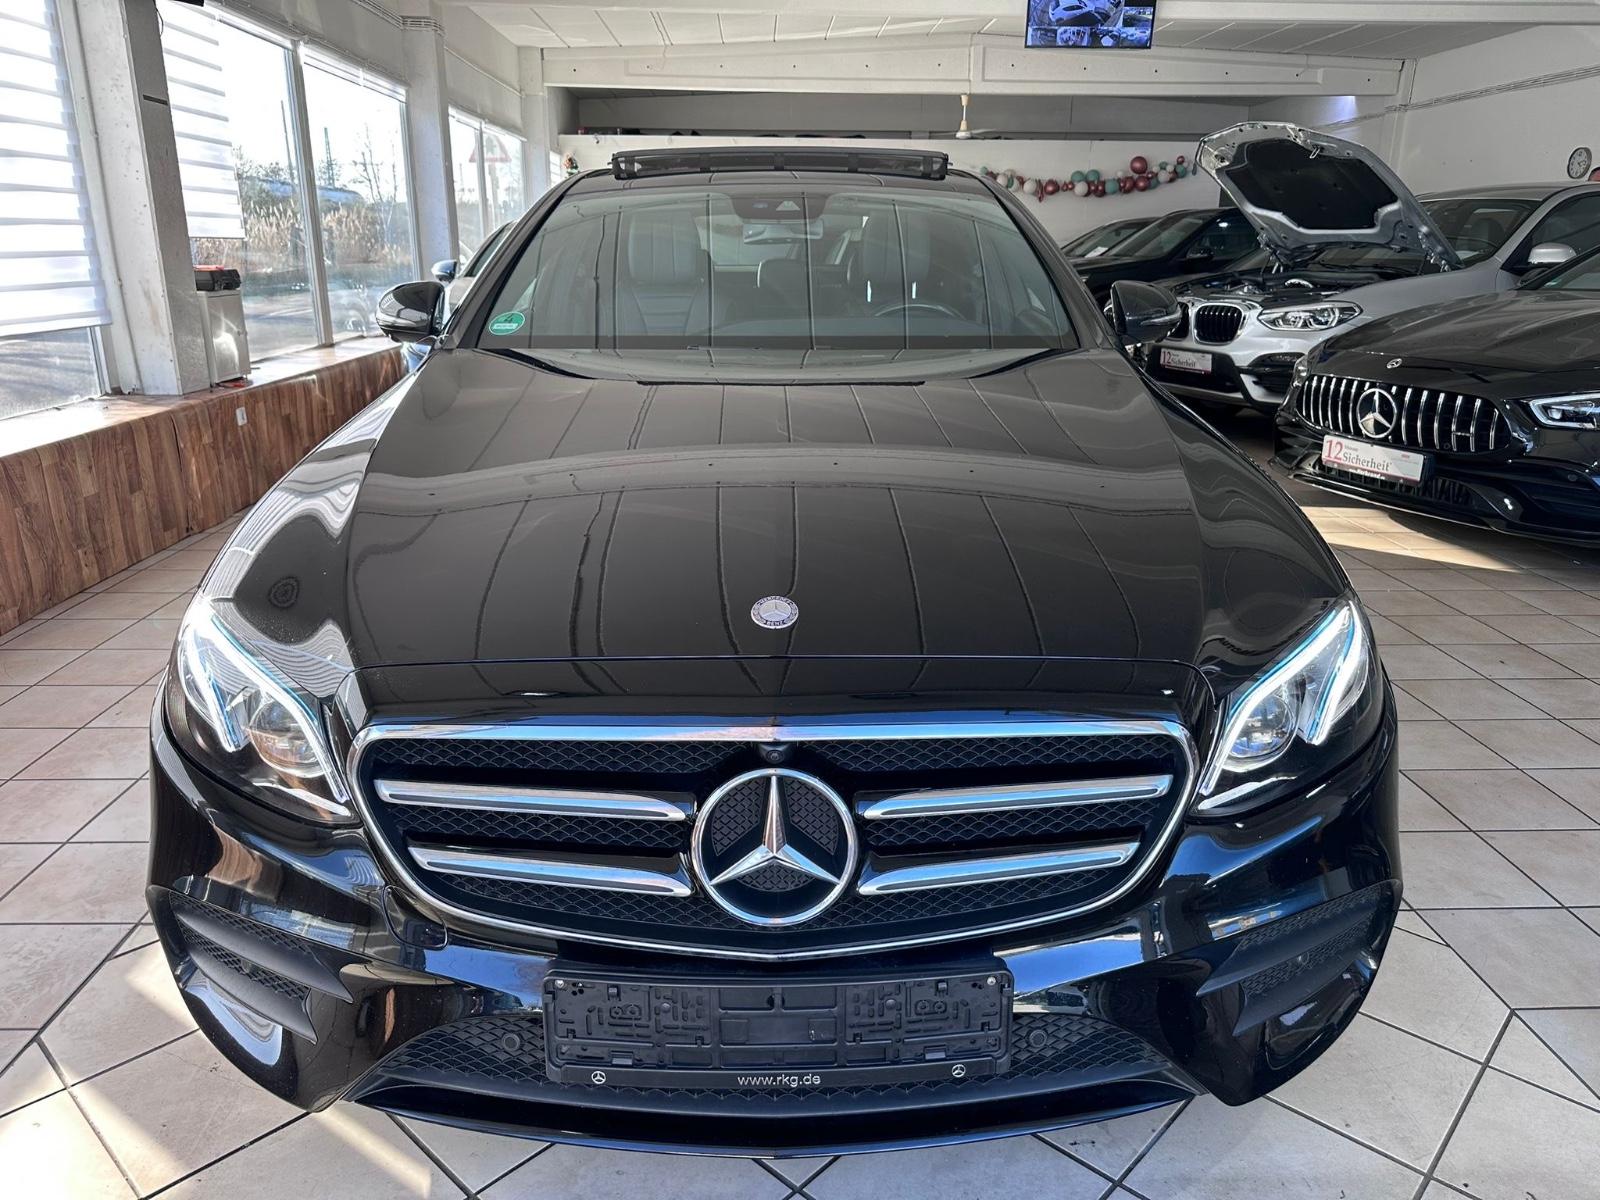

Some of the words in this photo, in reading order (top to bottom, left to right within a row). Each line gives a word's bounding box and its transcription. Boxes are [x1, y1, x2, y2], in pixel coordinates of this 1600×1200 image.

[1324, 440, 1344, 460] 12
[1343, 452, 1390, 471] Sicherheit
[737, 1074, 821, 1087] www.rkg.de
